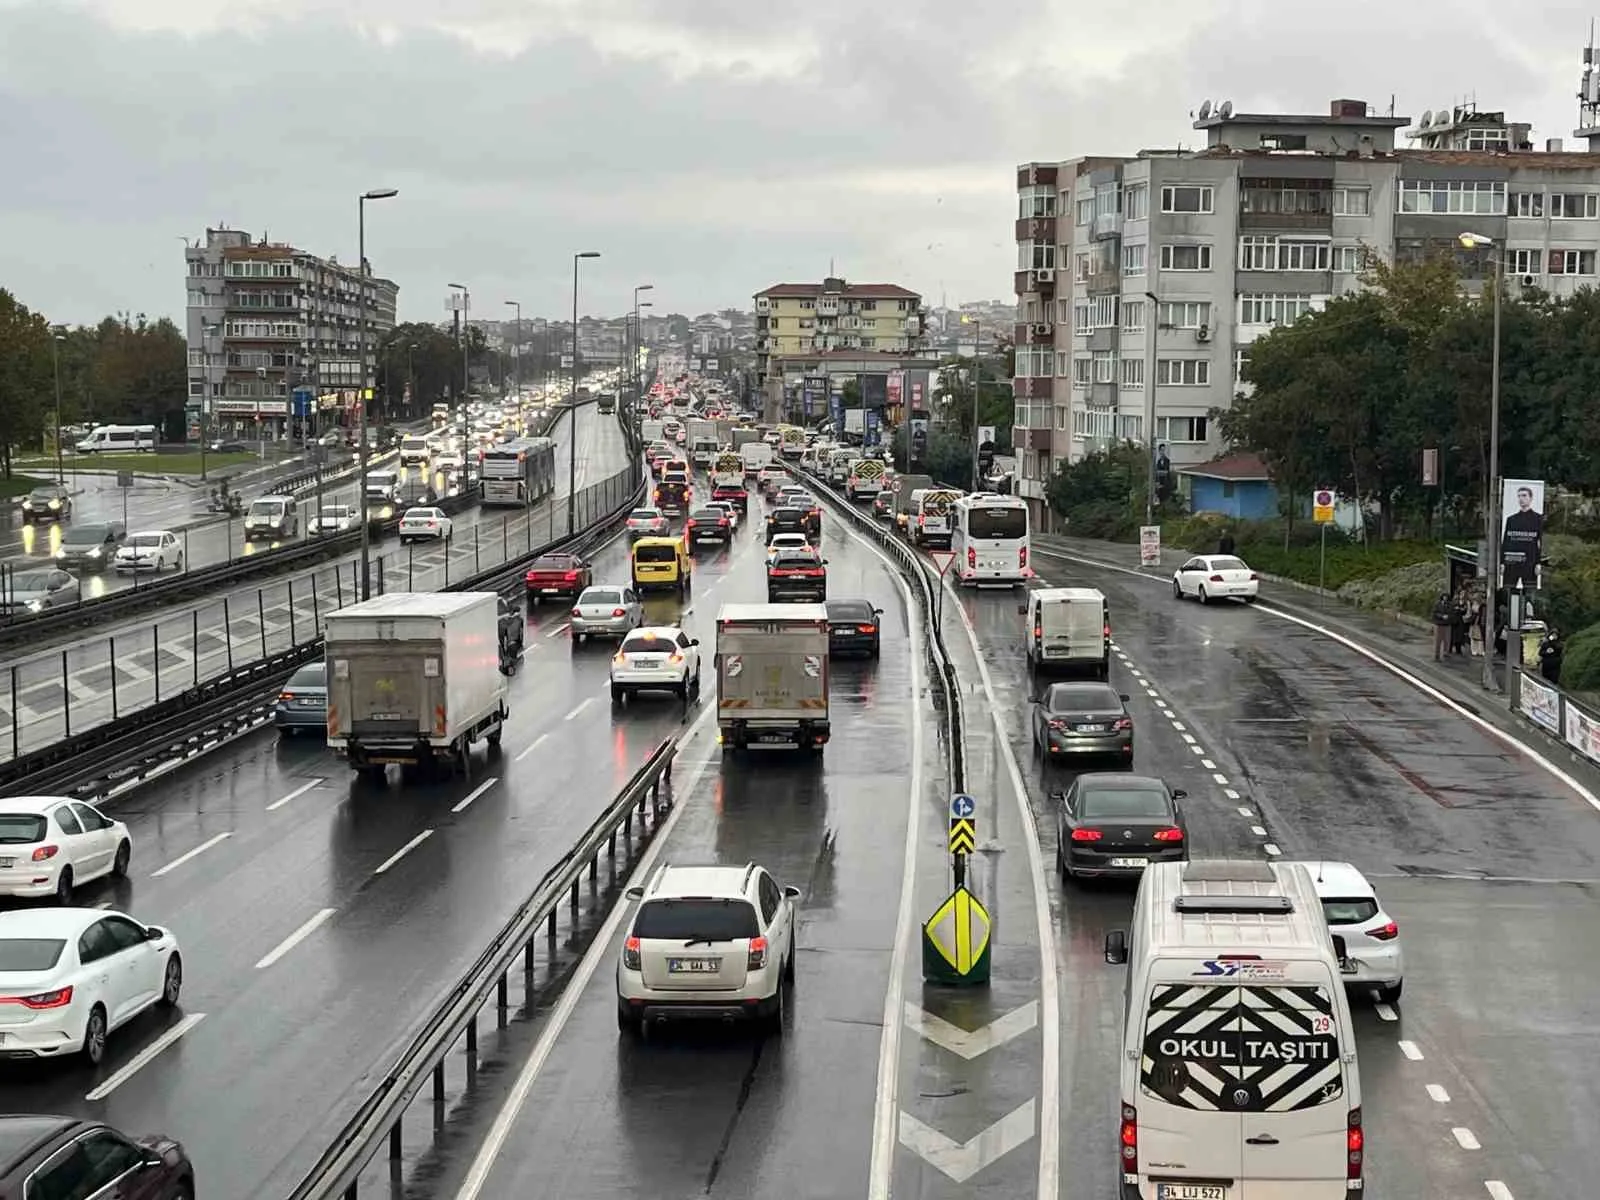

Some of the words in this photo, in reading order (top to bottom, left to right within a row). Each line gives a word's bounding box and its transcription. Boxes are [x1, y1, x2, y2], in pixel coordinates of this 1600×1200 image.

[1314, 1017, 1329, 1032] 29
[1159, 1038, 1236, 1058] OKUL
[1245, 1041, 1329, 1062] TAŞITI
[1164, 1186, 1177, 1198] 34
[1202, 1188, 1221, 1199] 522
